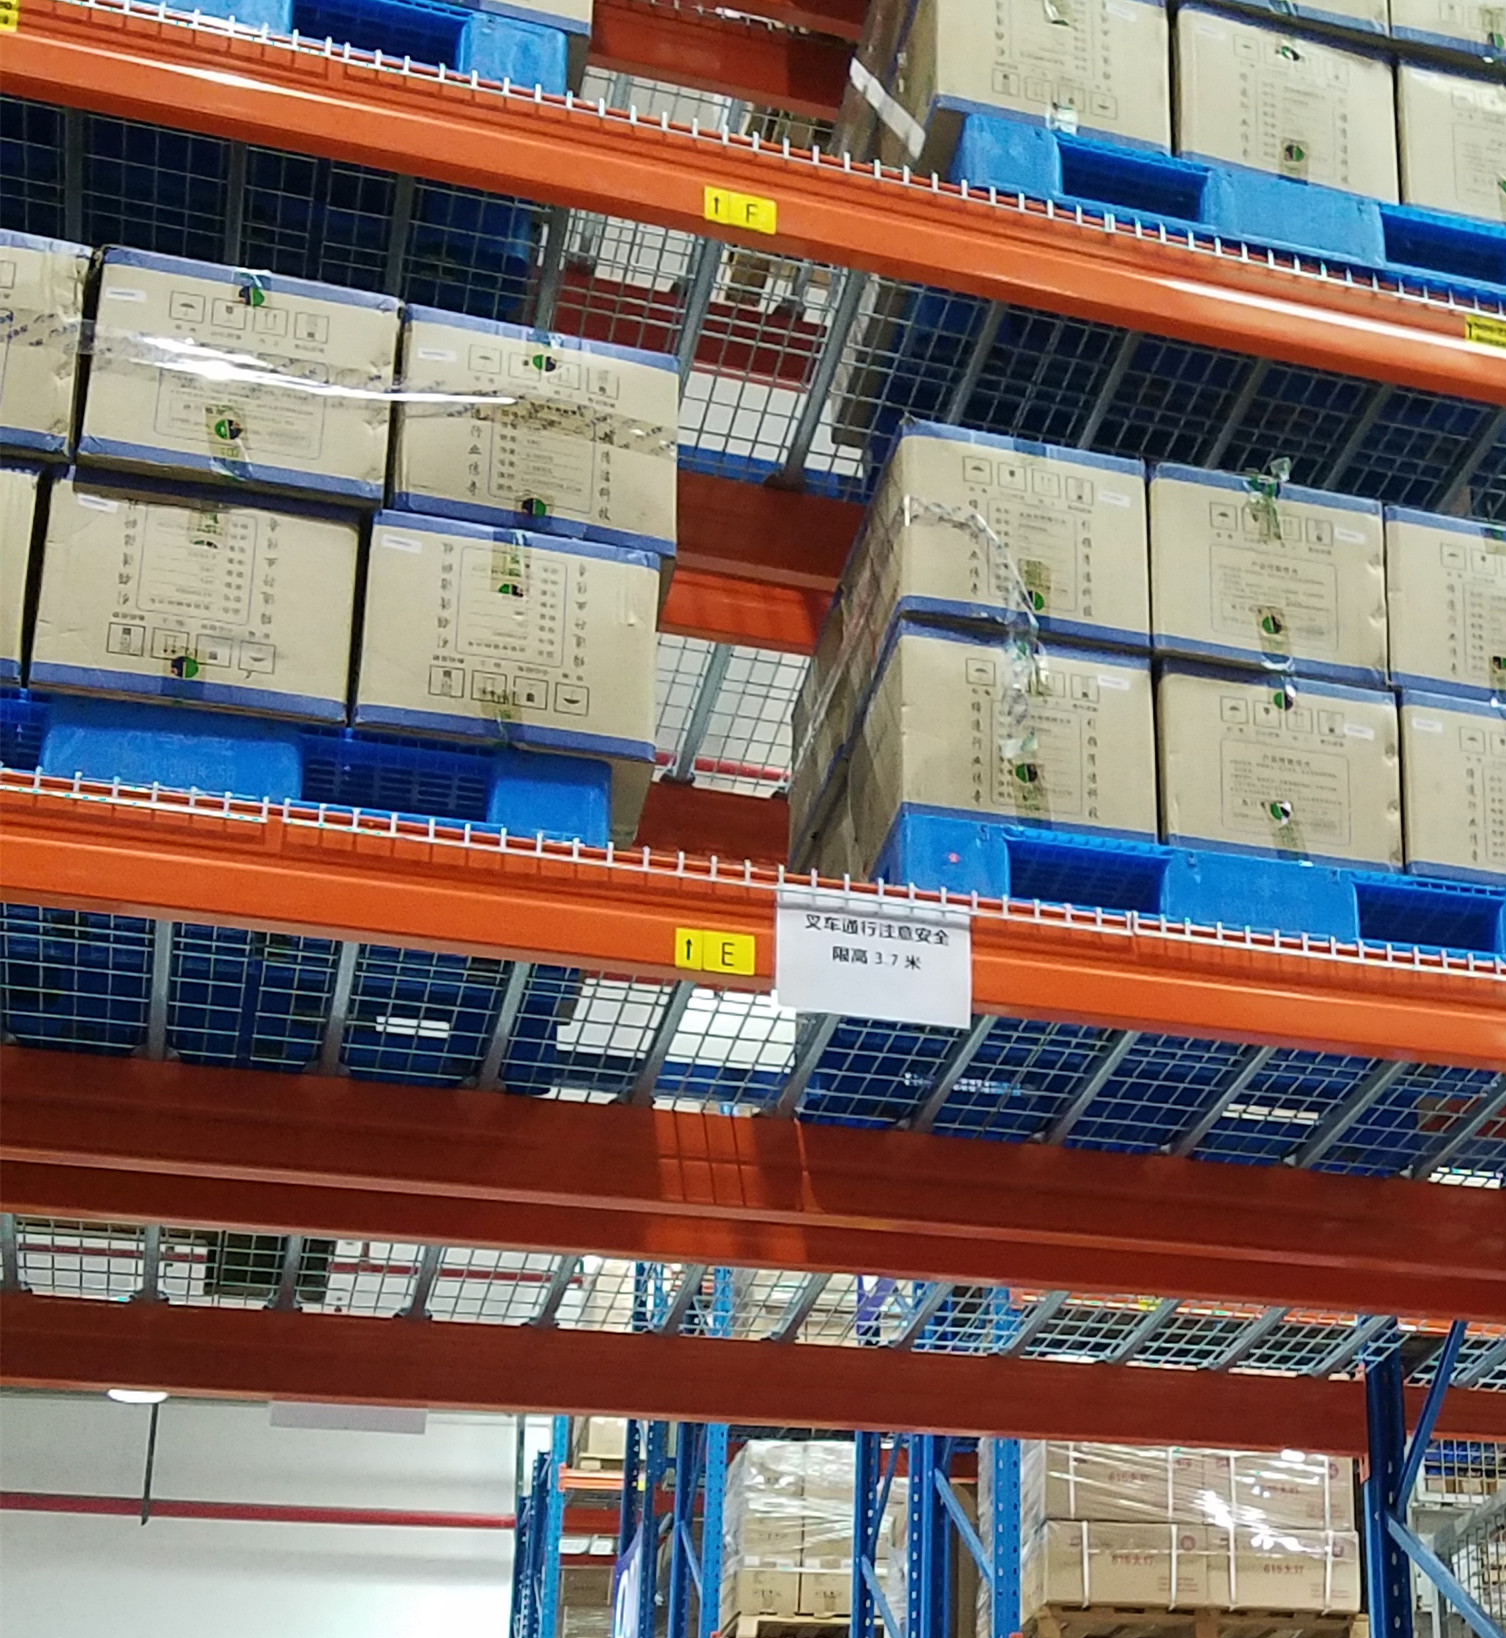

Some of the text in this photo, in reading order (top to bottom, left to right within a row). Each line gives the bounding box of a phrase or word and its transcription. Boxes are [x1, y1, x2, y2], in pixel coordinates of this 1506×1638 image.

[745, 203, 758, 223] F
[804, 913, 950, 946] 叉车通行注意安全
[720, 942, 736, 967] E
[832, 946, 922, 970] 限高 3.7 米
